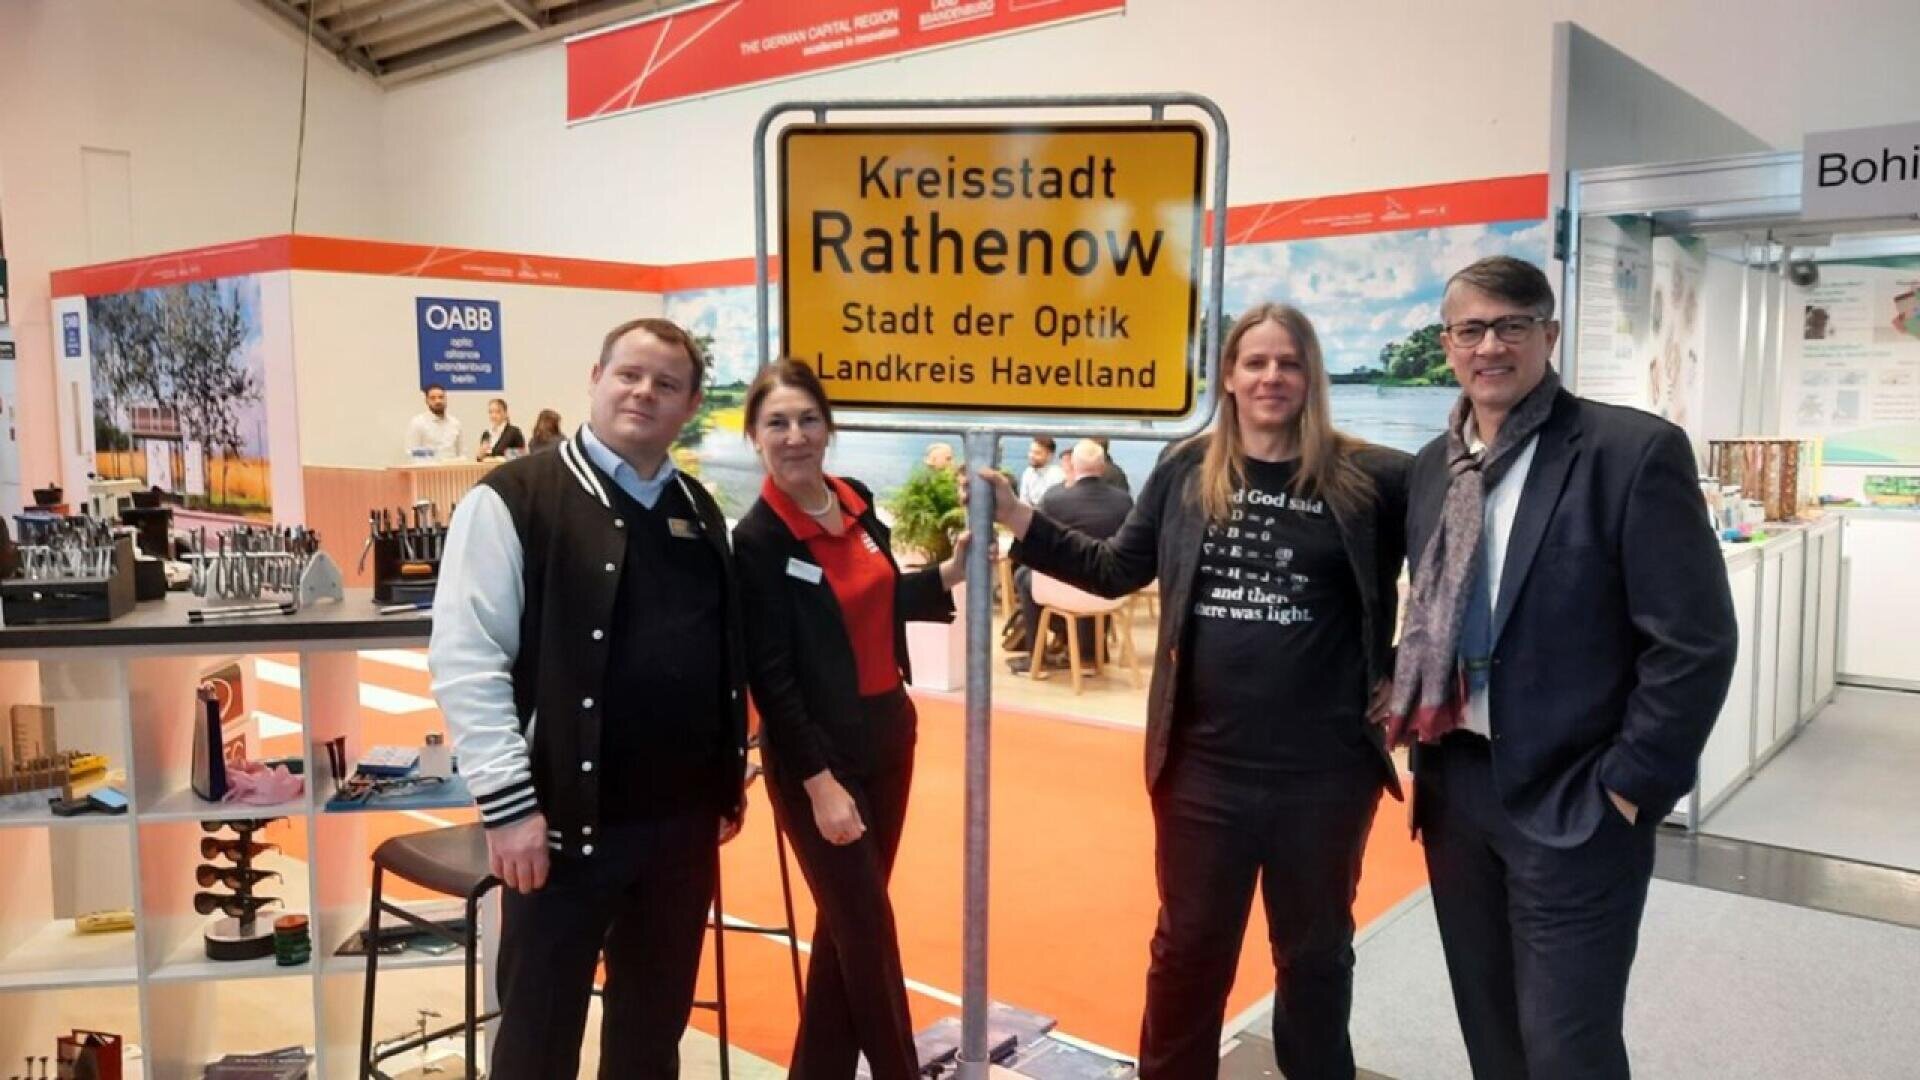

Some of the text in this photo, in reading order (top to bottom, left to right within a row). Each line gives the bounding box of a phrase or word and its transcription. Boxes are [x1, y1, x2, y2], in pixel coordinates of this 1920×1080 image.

[740, 8, 899, 56] THE GERMAN CAPITAL REGION
[859, 155, 1117, 199] Kreisstadt
[811, 210, 1164, 277] Rathenow
[425, 305, 493, 331] OABB
[842, 302, 1130, 346] Stadt der Optik
[434, 361, 492, 373] brandenburg
[451, 374, 477, 384] berlin
[816, 353, 1156, 388] Landkreis Havelland
[1247, 489, 1287, 508] God
[1288, 497, 1323, 515] said
[1211, 585, 1244, 601] and
[1230, 606, 1264, 620] was
